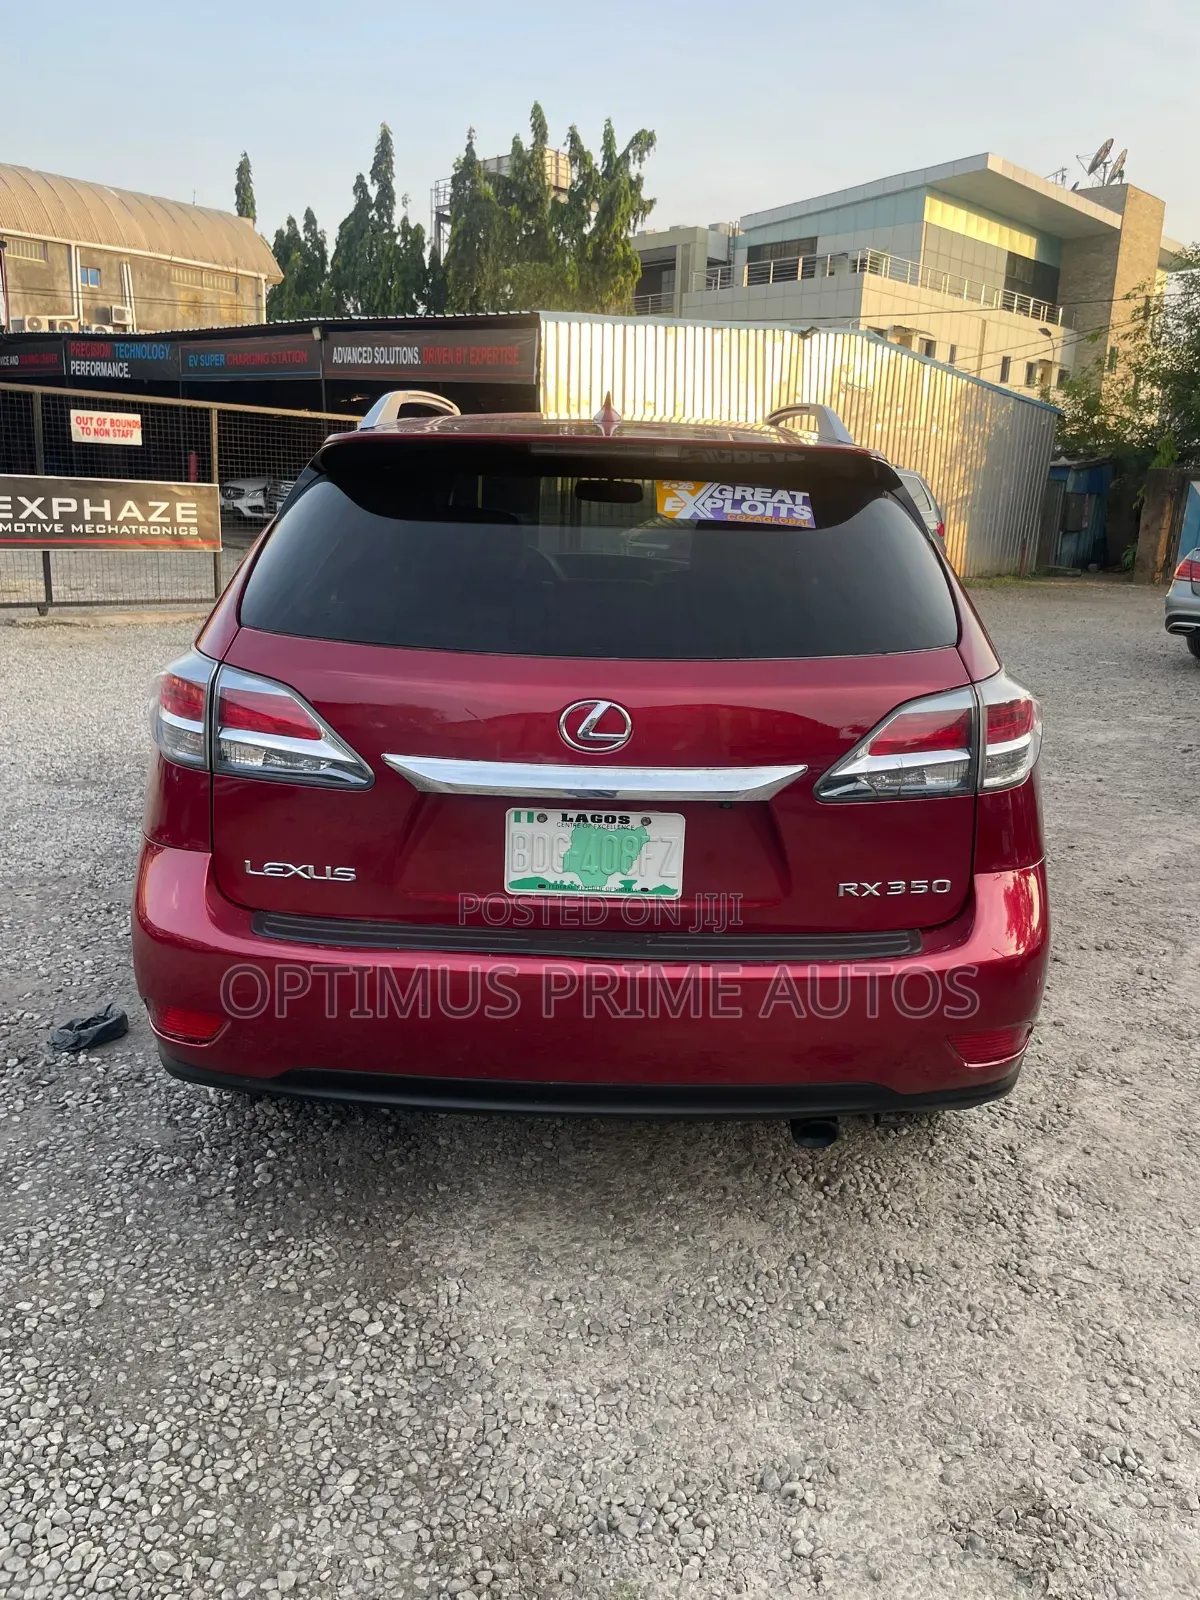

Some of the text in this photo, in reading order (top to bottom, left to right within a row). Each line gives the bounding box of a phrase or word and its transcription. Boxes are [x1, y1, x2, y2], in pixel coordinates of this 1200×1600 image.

[70, 342, 172, 361] PRECISION TECHNOLOGY.
[188, 349, 308, 367] EV SUPER CHARGING STATION
[332, 345, 520, 365] ADVANCED SOLUTIONS. DRIVEN BY EXPERTISE
[70, 360, 131, 378] PERFORMANCE.
[75, 415, 141, 430] OUT OF BOUNDS
[80, 426, 134, 439] TO NON STAFF
[712, 485, 810, 505] GREAT
[0, 495, 199, 523] EXPHAZE
[0, 522, 199, 536] MOTIVE MECHATRONICS
[727, 513, 812, 527] COZAGLOBAL
[556, 821, 578, 829] CENTRE
[593, 823, 635, 831] EXCELLENCE
[560, 812, 631, 825] LAGOS
[244, 859, 357, 882] LEXUS
